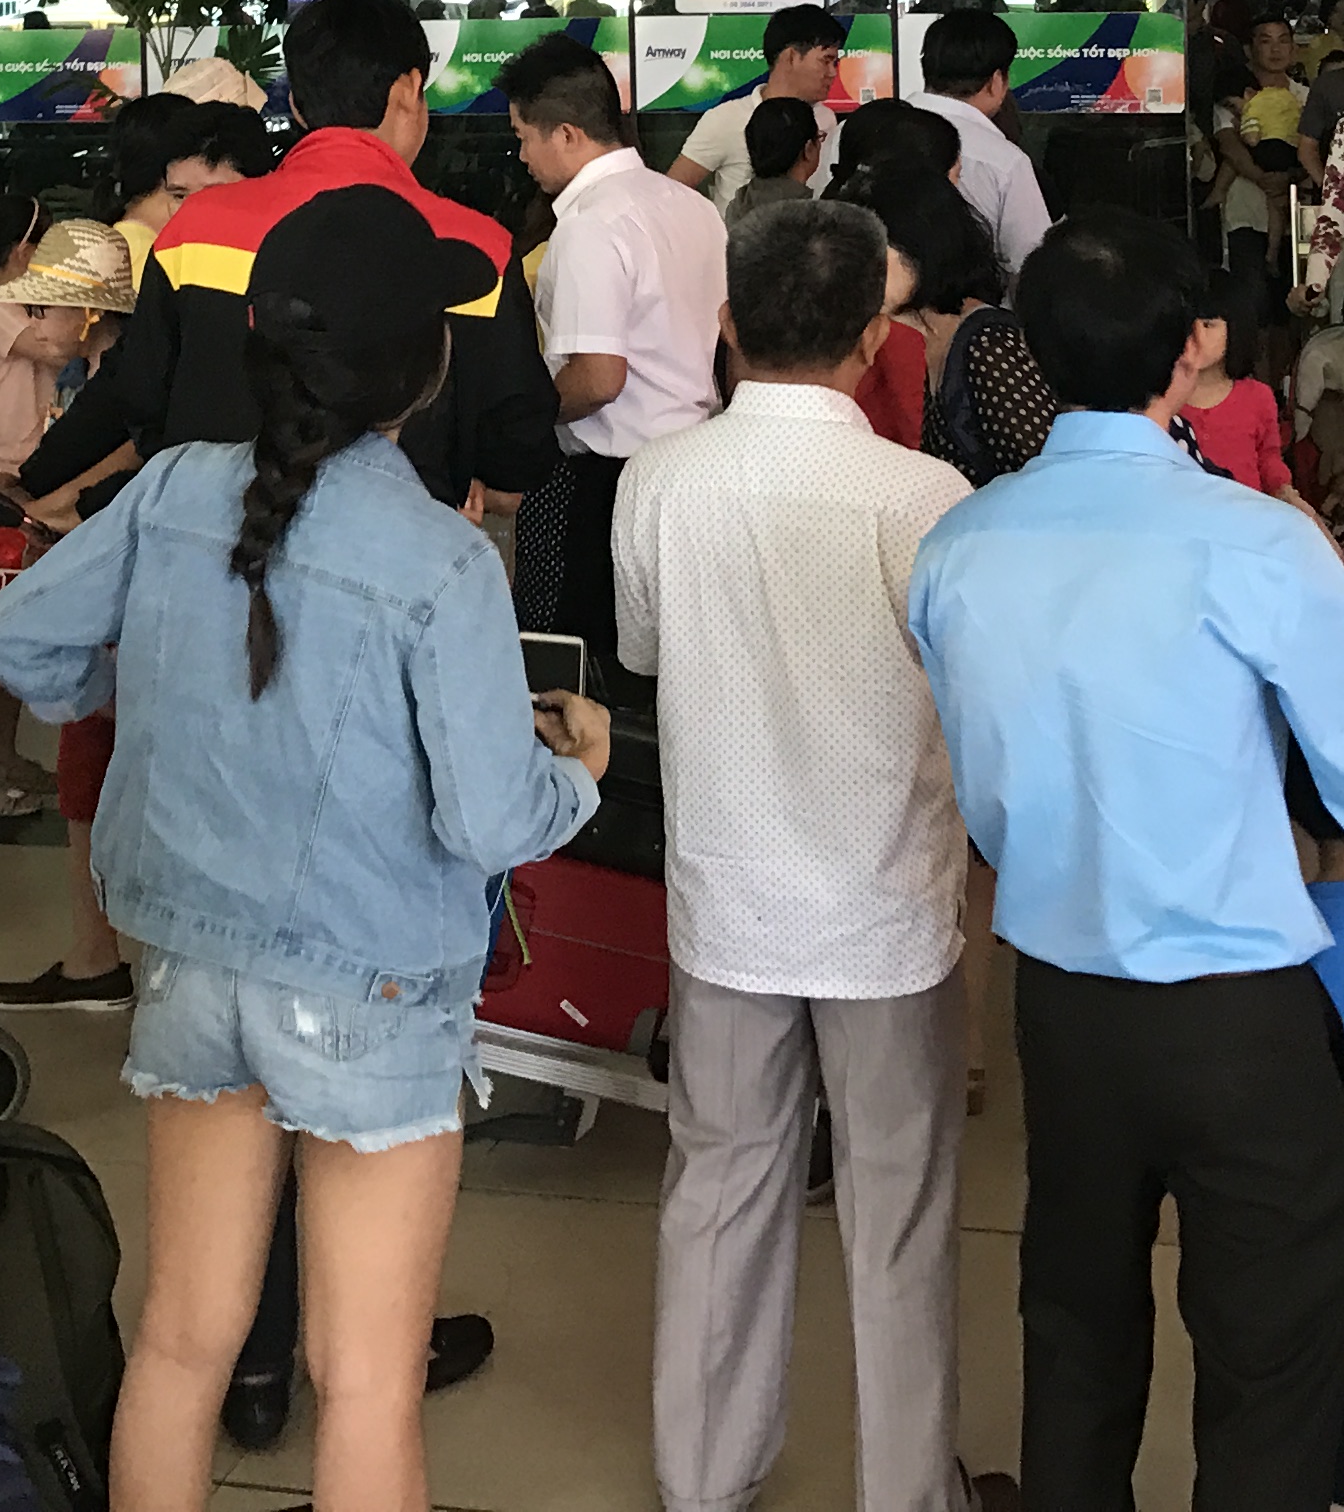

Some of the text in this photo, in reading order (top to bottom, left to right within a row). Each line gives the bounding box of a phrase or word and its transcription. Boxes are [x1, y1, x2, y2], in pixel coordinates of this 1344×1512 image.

[644, 44, 688, 62] Amway
[1046, 43, 1080, 59] SỐNG
[1082, 44, 1106, 59] TỐT
[1107, 47, 1131, 61] ĐẸP
